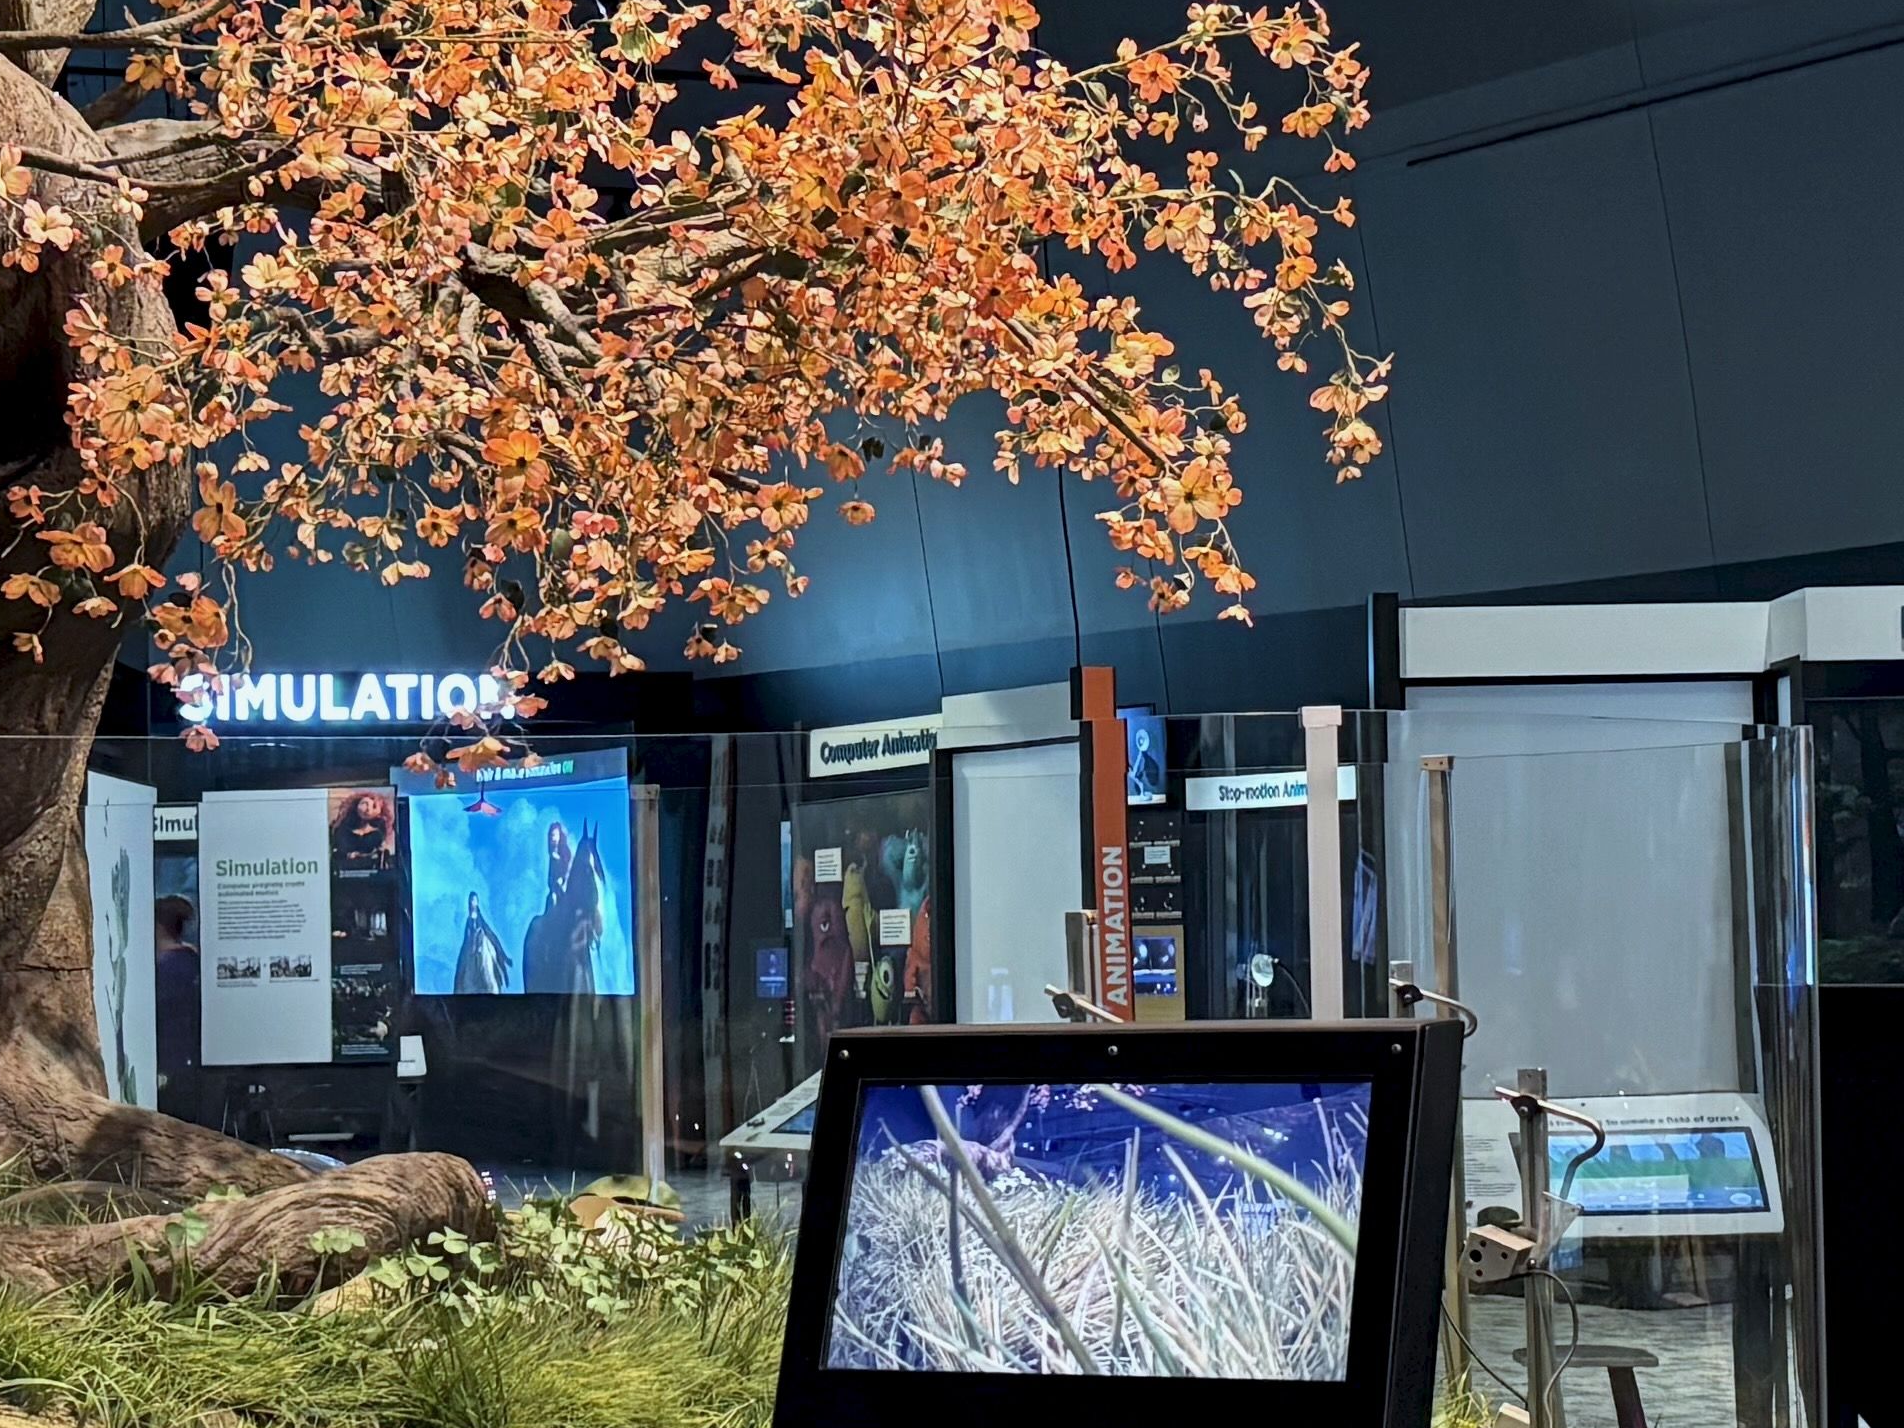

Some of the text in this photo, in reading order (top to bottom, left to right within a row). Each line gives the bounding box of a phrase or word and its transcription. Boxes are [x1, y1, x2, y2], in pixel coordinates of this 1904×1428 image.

[179, 673, 516, 721] SIMULATION
[820, 737, 880, 765] Computer
[1218, 782, 1280, 803] Stop-motion
[215, 858, 319, 877] Simulation
[1101, 845, 1129, 1008] ANIMATION
